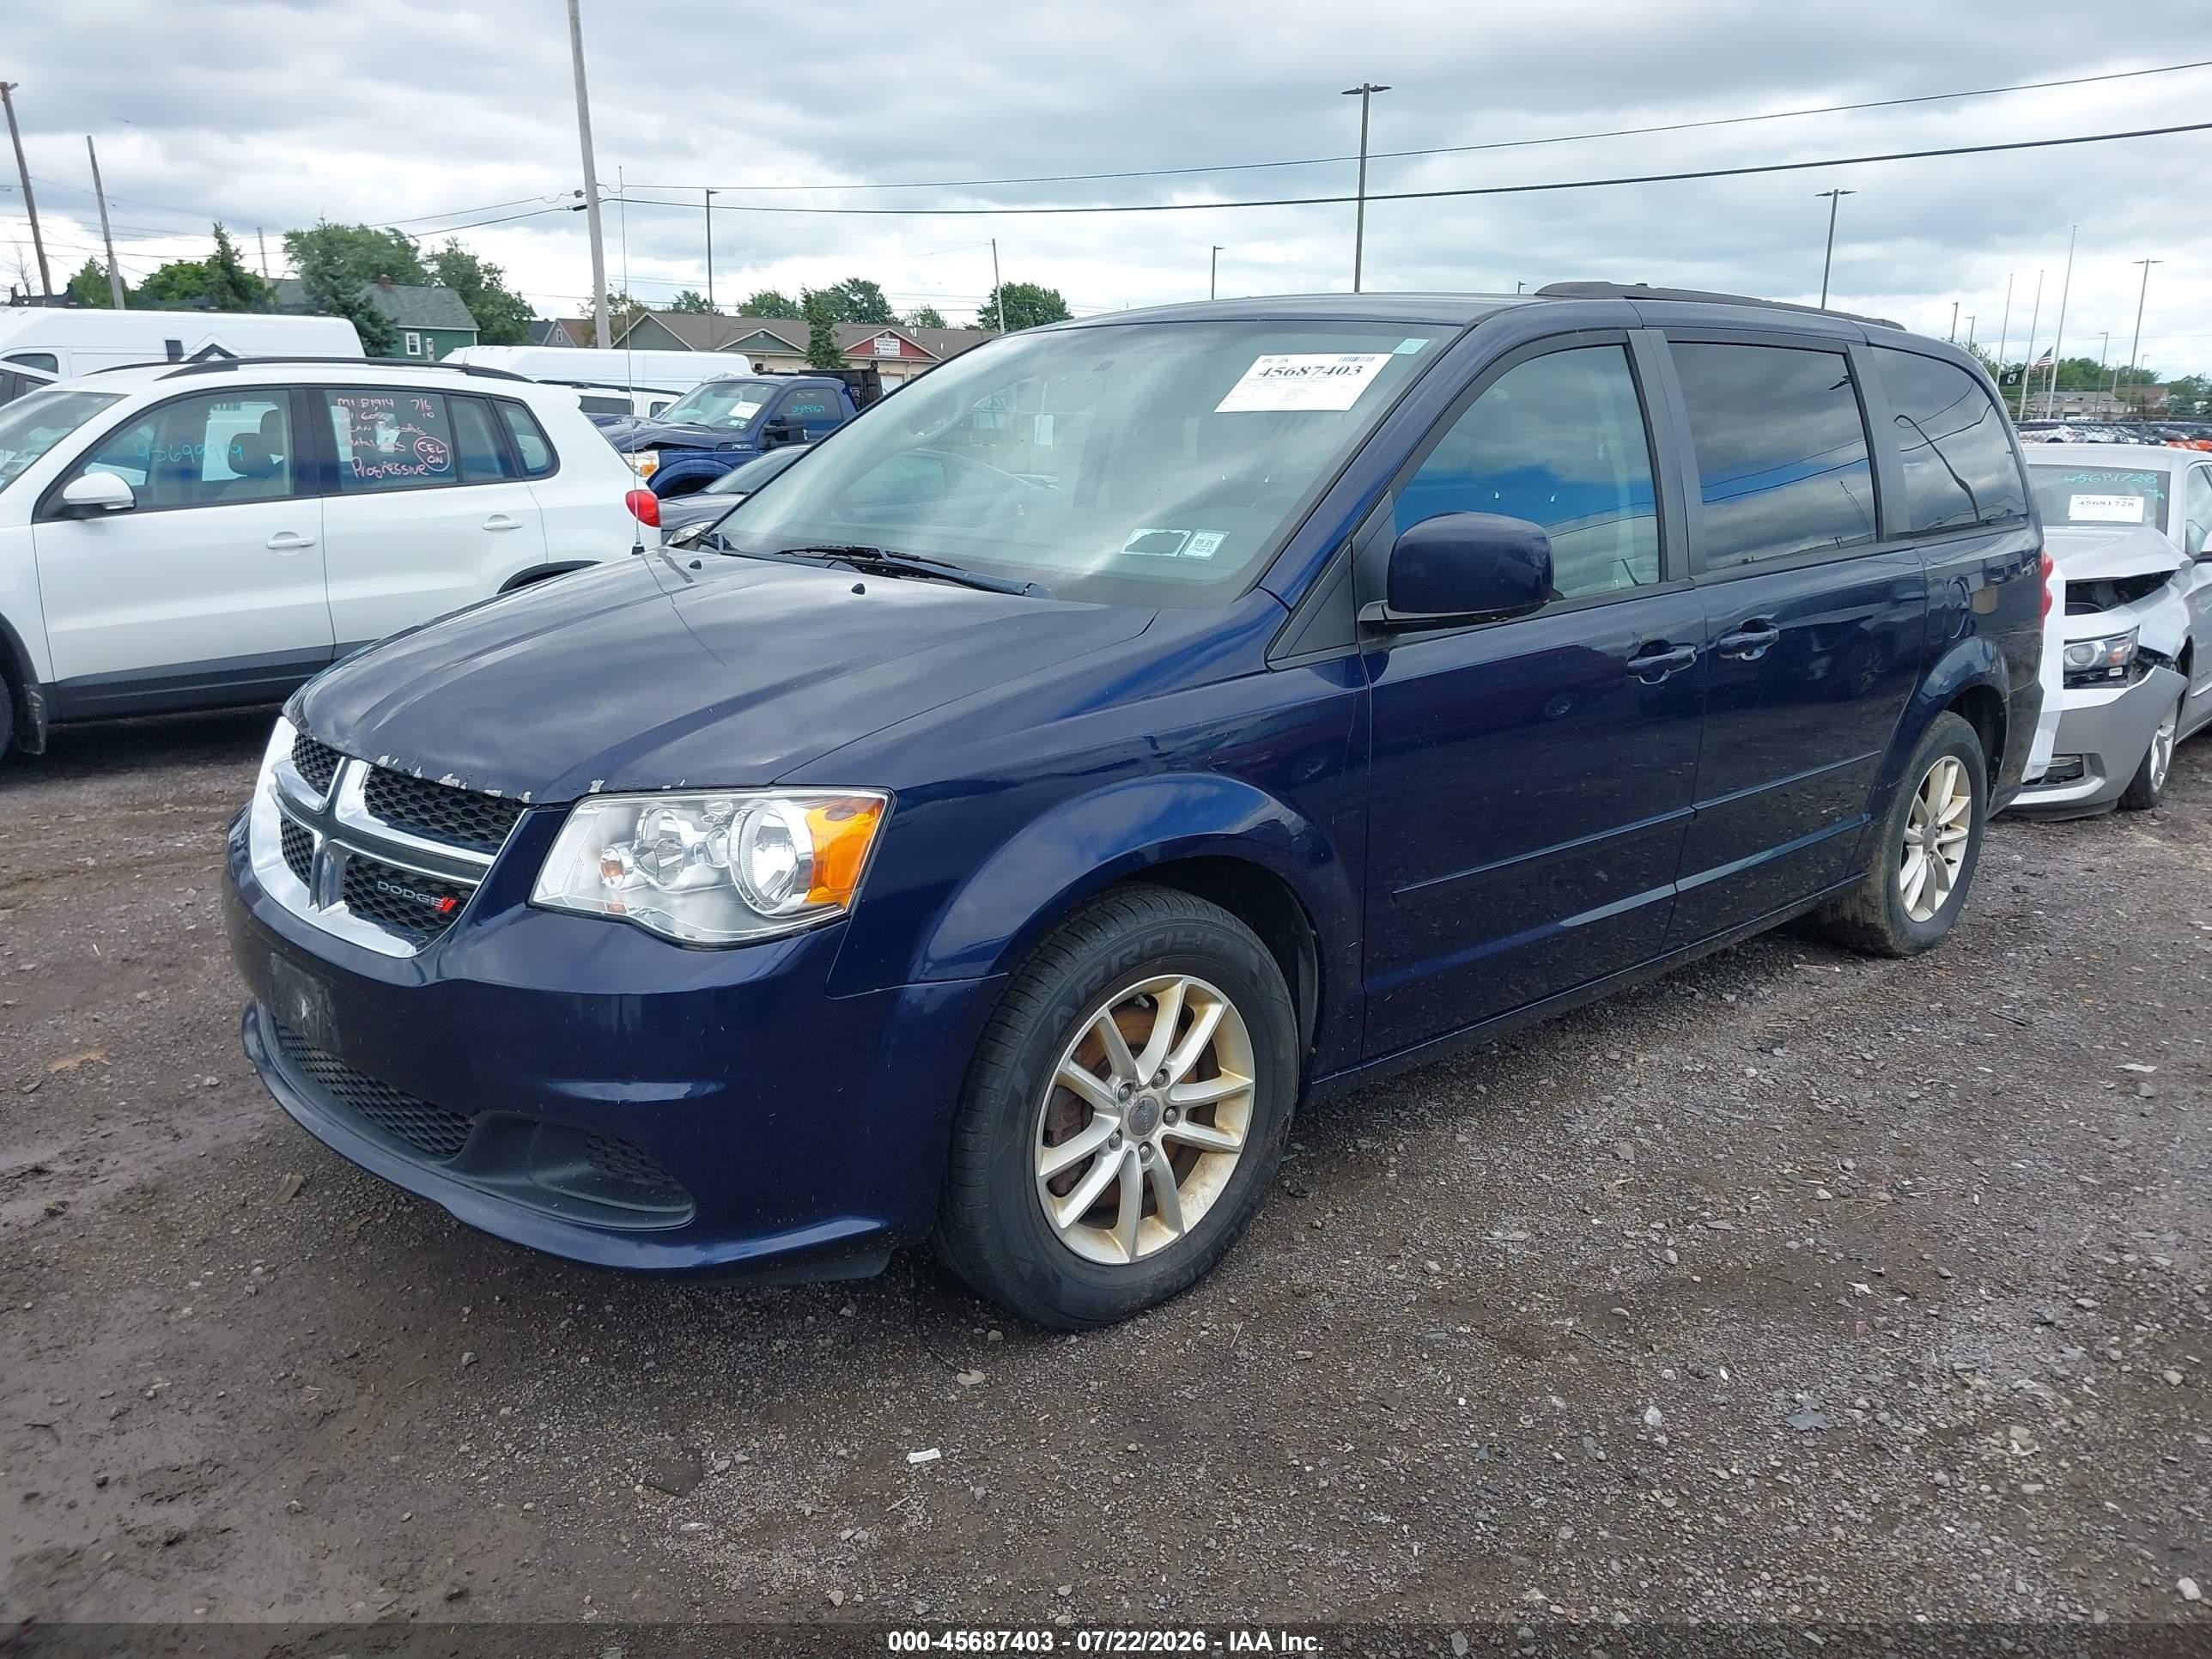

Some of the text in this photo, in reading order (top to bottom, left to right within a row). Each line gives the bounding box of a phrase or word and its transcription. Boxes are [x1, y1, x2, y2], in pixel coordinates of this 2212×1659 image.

[1258, 364, 1364, 378] 45687403
[416, 441, 446, 454] CEL
[426, 455, 444, 465] ON
[350, 456, 430, 479] Progressive
[2063, 472, 2158, 484] 45681728
[378, 880, 444, 908] DODGE
